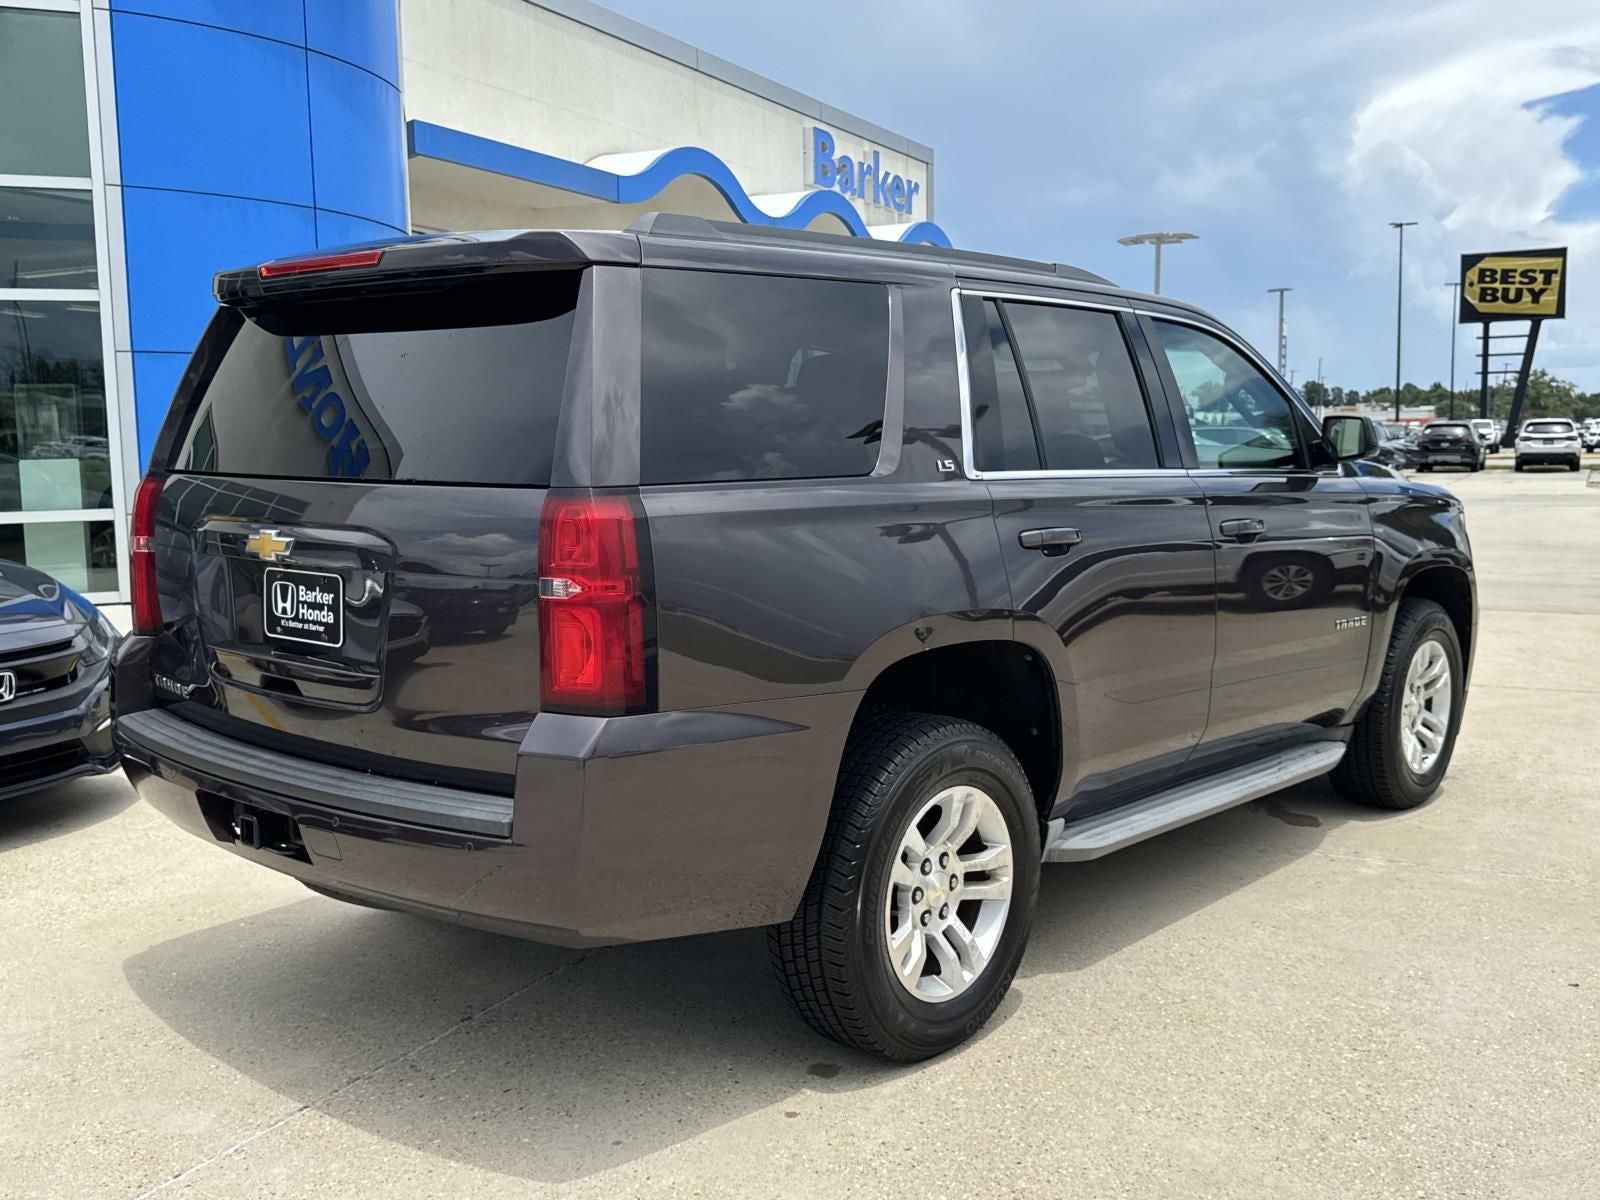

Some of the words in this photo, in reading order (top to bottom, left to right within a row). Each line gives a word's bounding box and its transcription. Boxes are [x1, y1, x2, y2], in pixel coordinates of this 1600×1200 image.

[813, 127, 919, 215] Barker
[1478, 268, 1558, 285] BEST
[1479, 287, 1549, 304] BUY
[936, 459, 955, 472] LS
[298, 585, 334, 604] Barker
[298, 603, 334, 623] Honda
[289, 620, 303, 629] Better
[309, 624, 326, 632] Barker
[1335, 615, 1368, 630] TAHOE
